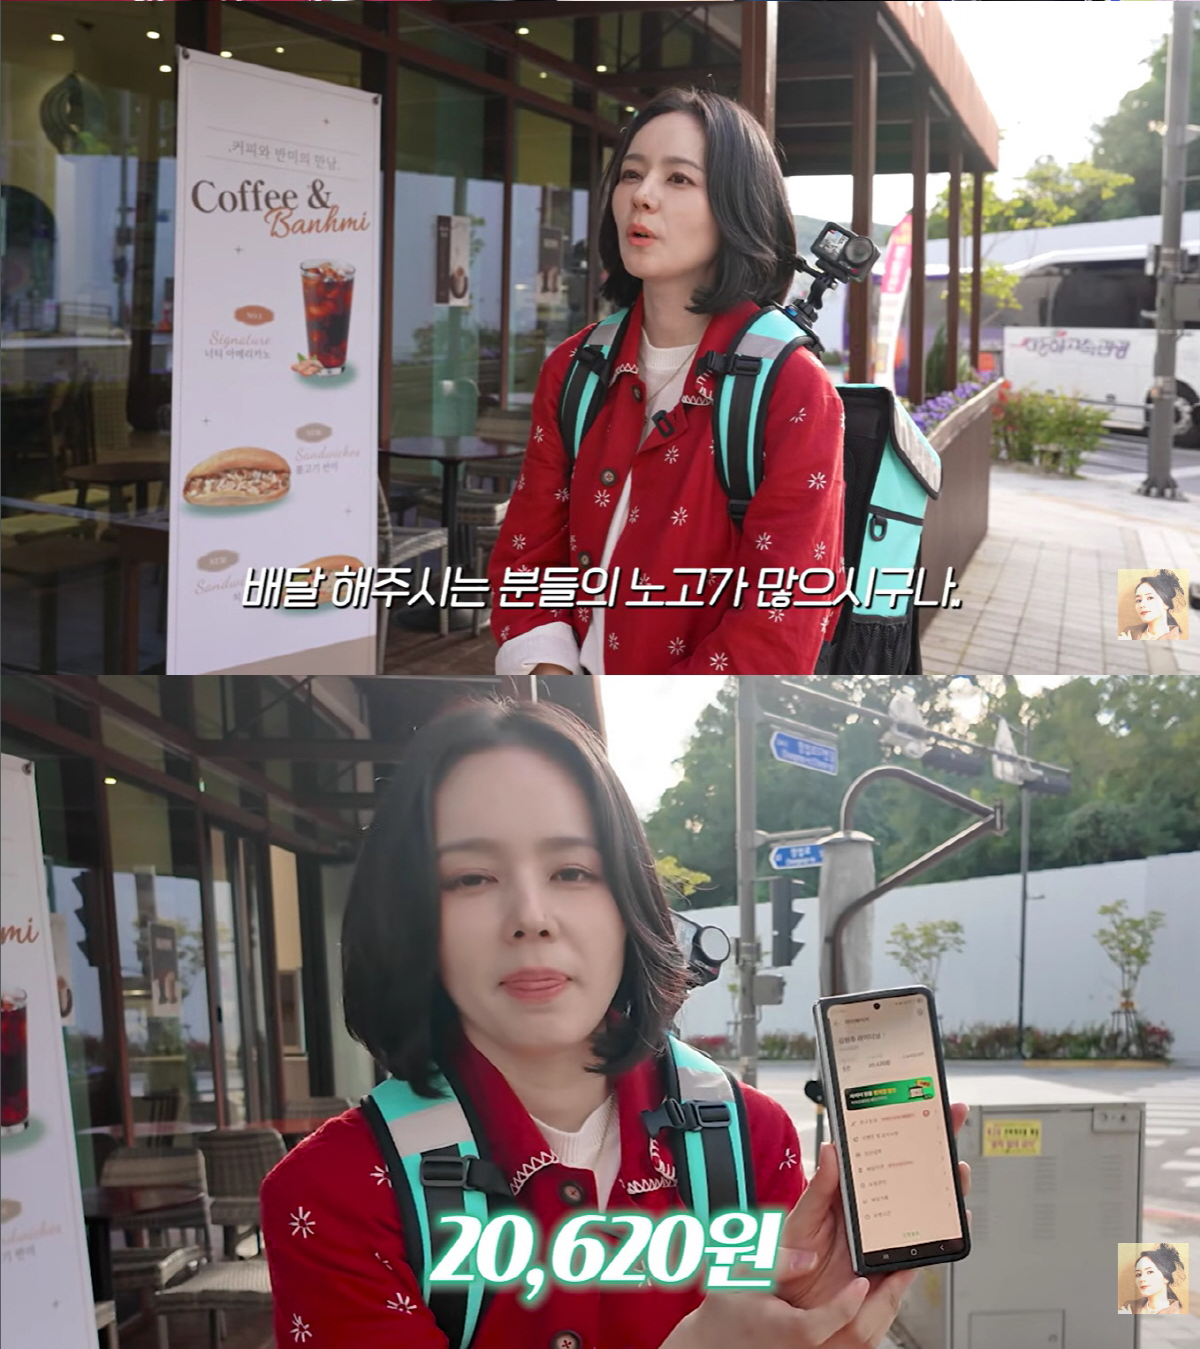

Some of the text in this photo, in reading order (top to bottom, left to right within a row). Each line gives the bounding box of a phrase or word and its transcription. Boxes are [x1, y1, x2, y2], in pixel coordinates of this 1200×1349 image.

[191, 178, 333, 214] Coffee &
[264, 204, 371, 239] Banhmi
